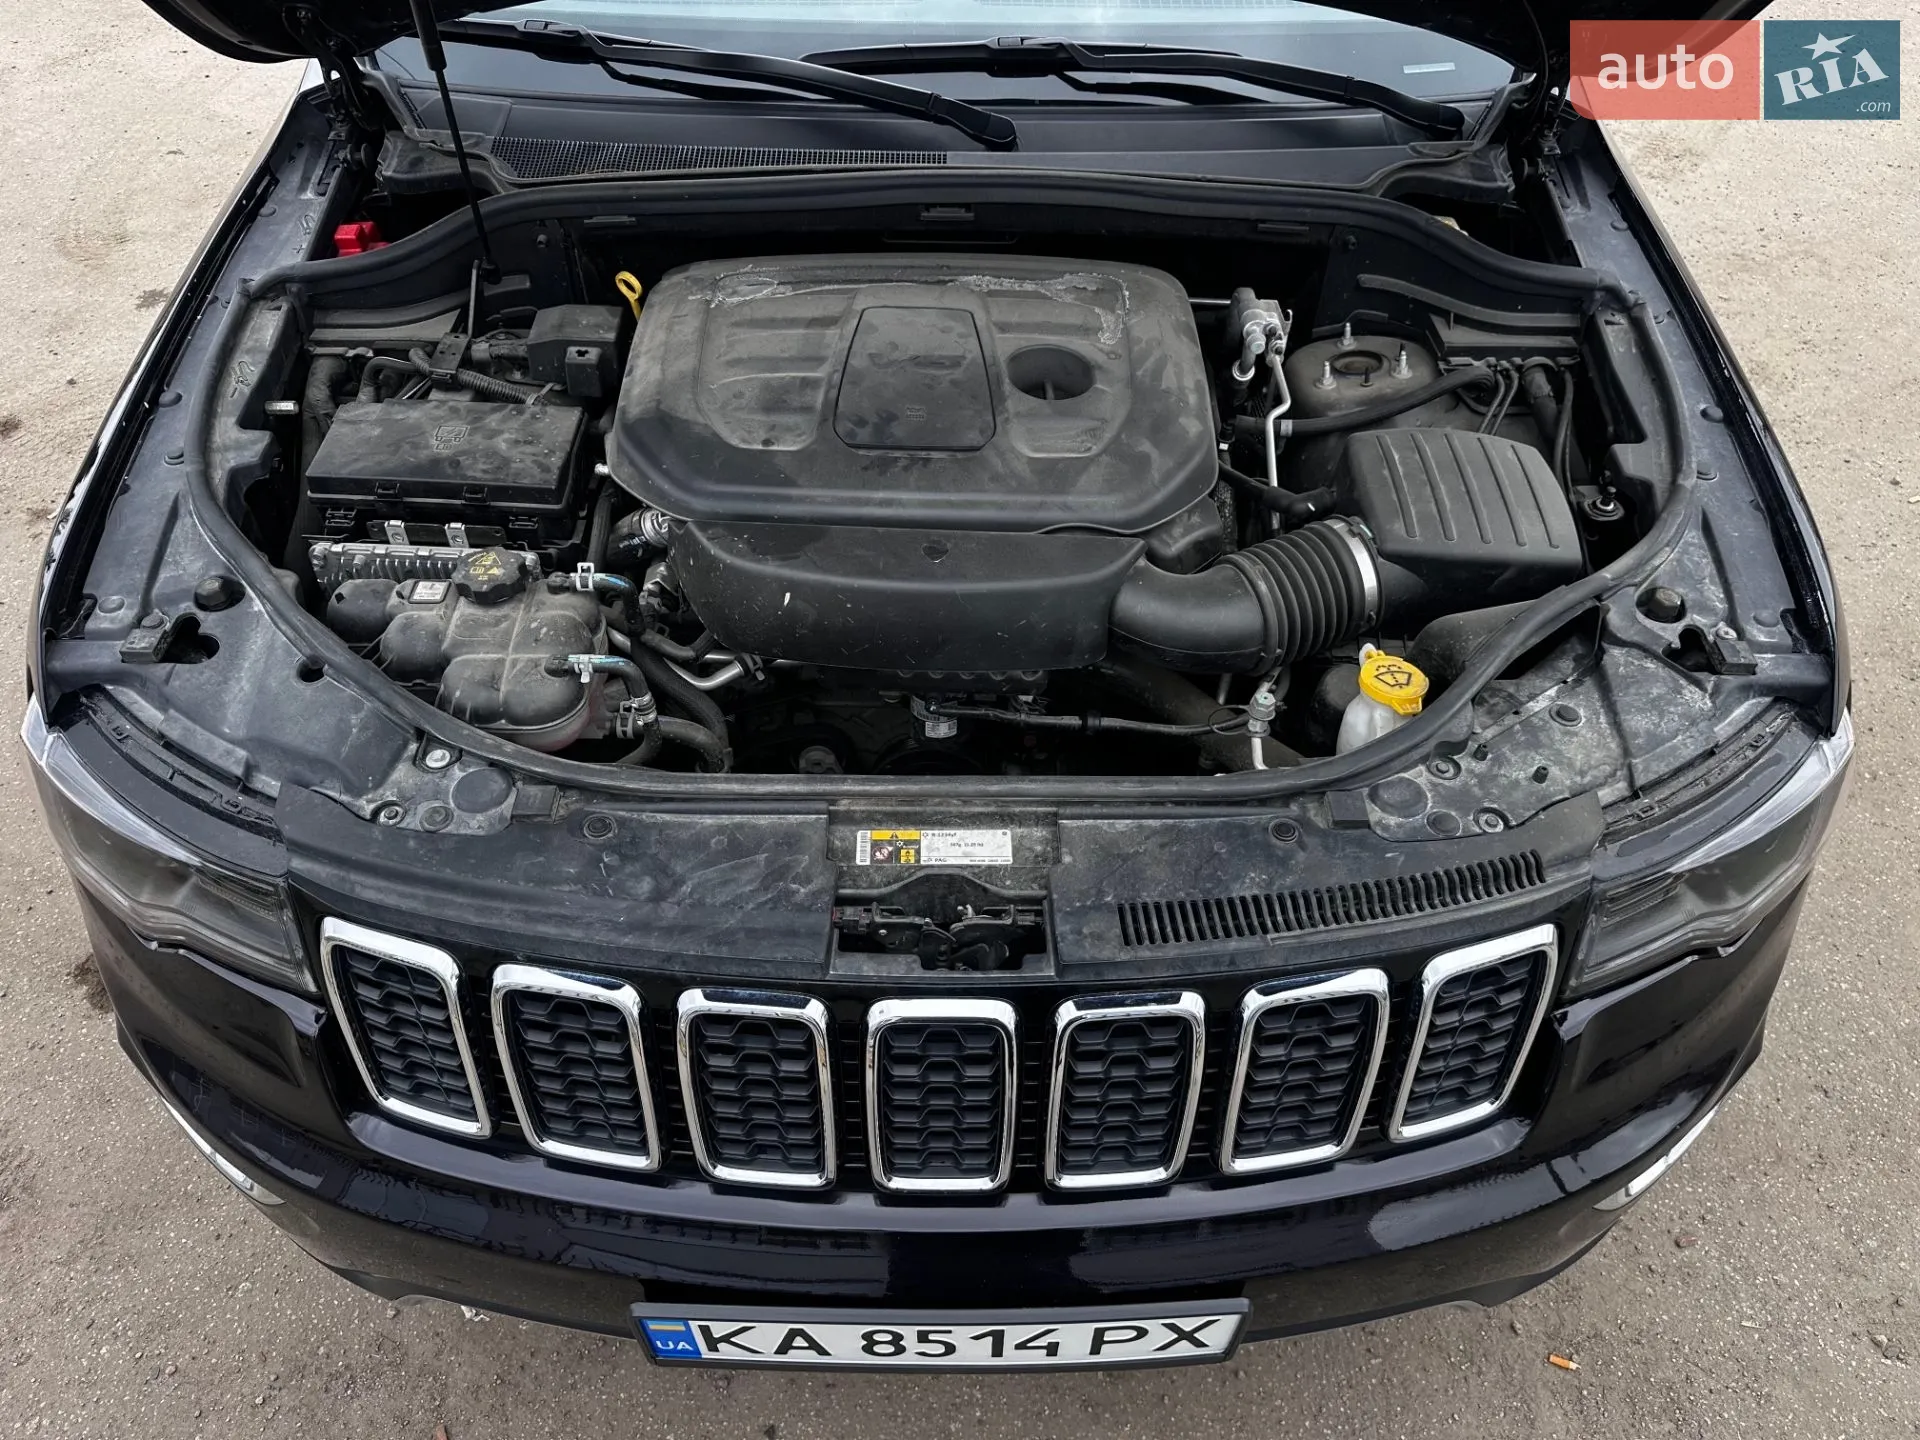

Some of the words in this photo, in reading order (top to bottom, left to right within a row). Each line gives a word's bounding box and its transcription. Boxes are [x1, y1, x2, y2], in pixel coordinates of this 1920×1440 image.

[656, 1340, 693, 1351] UA
[697, 1324, 833, 1357] KA
[860, 1328, 1060, 1358] 8514
[1088, 1318, 1222, 1356] PX
